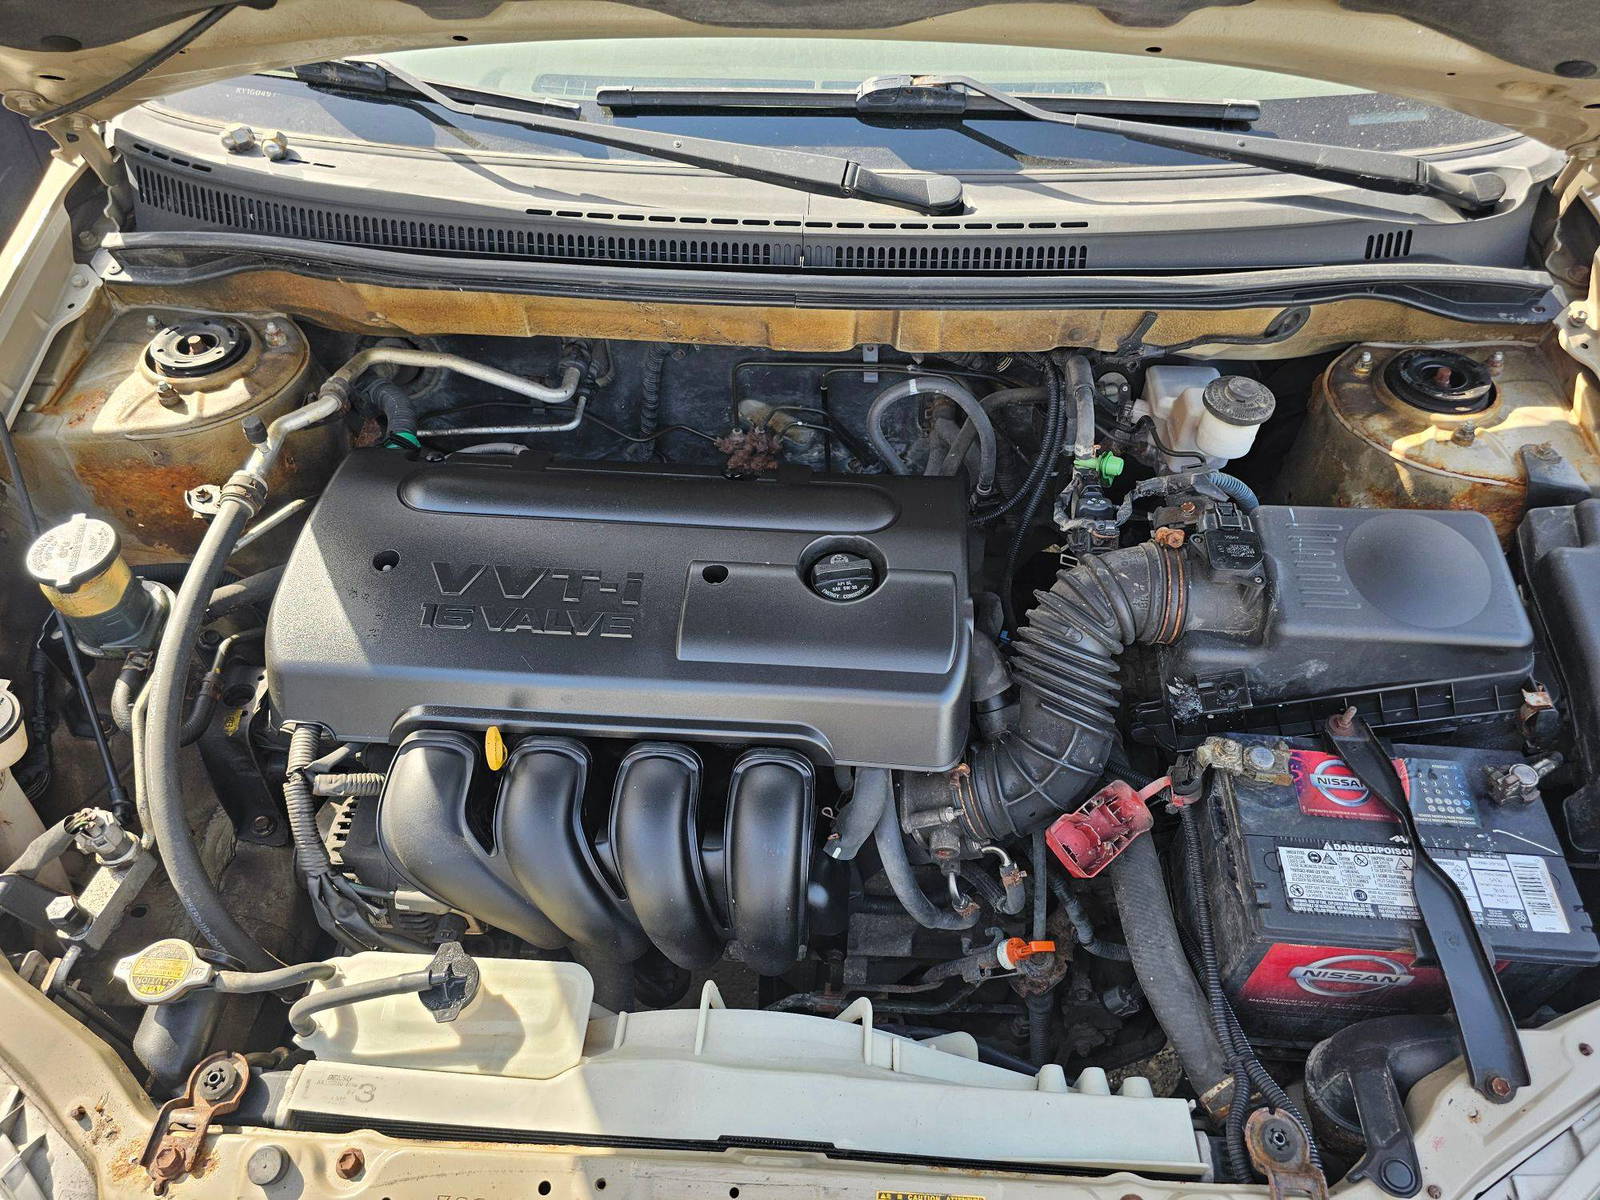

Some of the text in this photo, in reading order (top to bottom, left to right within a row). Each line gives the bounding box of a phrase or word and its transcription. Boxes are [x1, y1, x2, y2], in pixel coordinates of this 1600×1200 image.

[431, 560, 644, 605] VVT-i
[419, 602, 635, 639] 16 VALVE
[1317, 776, 1364, 788] NISSA
[1302, 968, 1400, 985] NISSAN
[355, 1083, 377, 1103] 3
